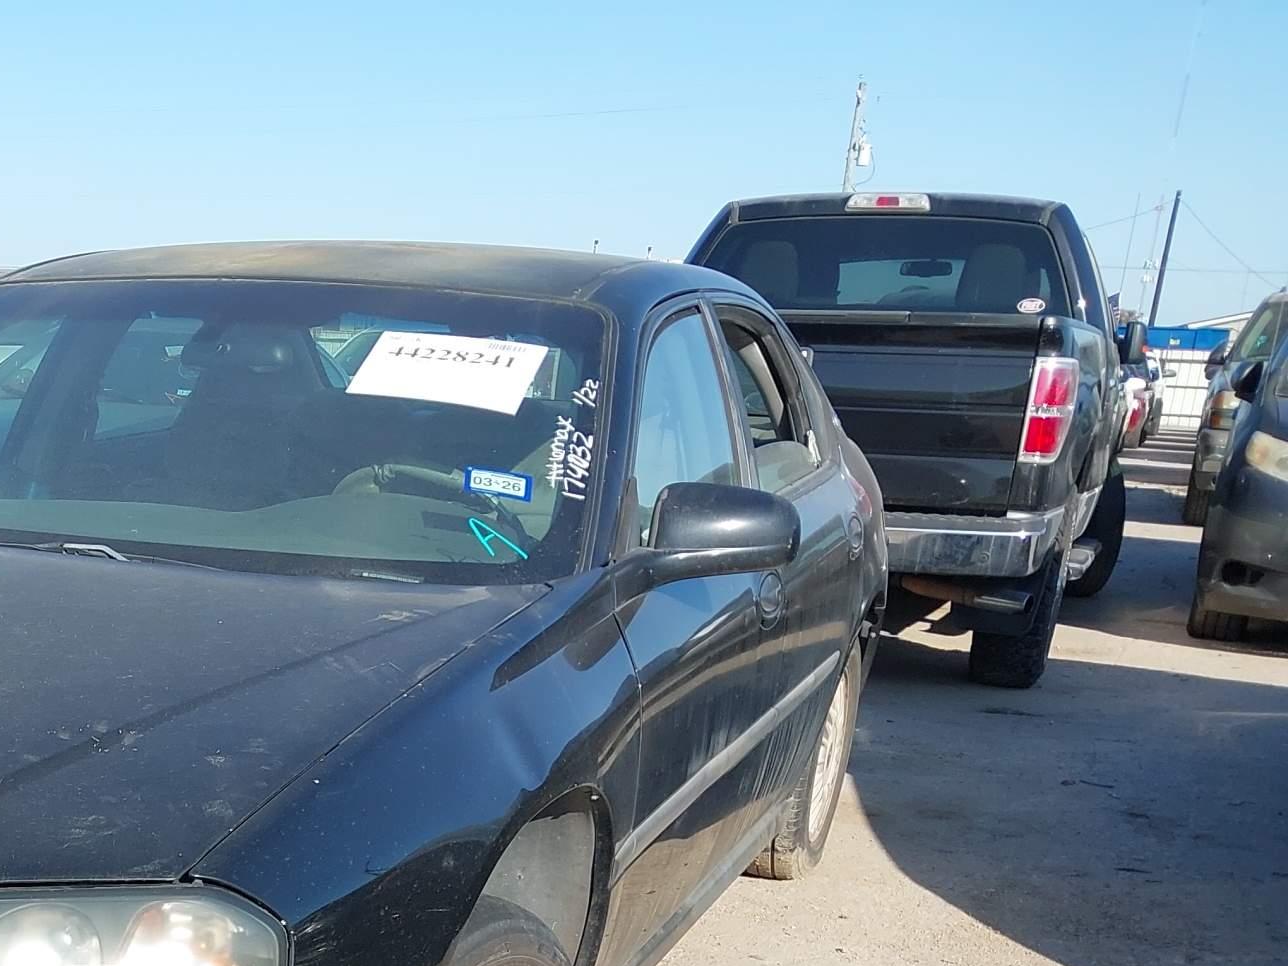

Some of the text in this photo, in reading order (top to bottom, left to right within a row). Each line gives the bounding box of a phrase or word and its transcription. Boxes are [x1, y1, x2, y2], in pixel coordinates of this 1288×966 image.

[388, 346, 515, 368] 44228241
[572, 378, 600, 407] 1/22
[468, 517, 528, 559] A
